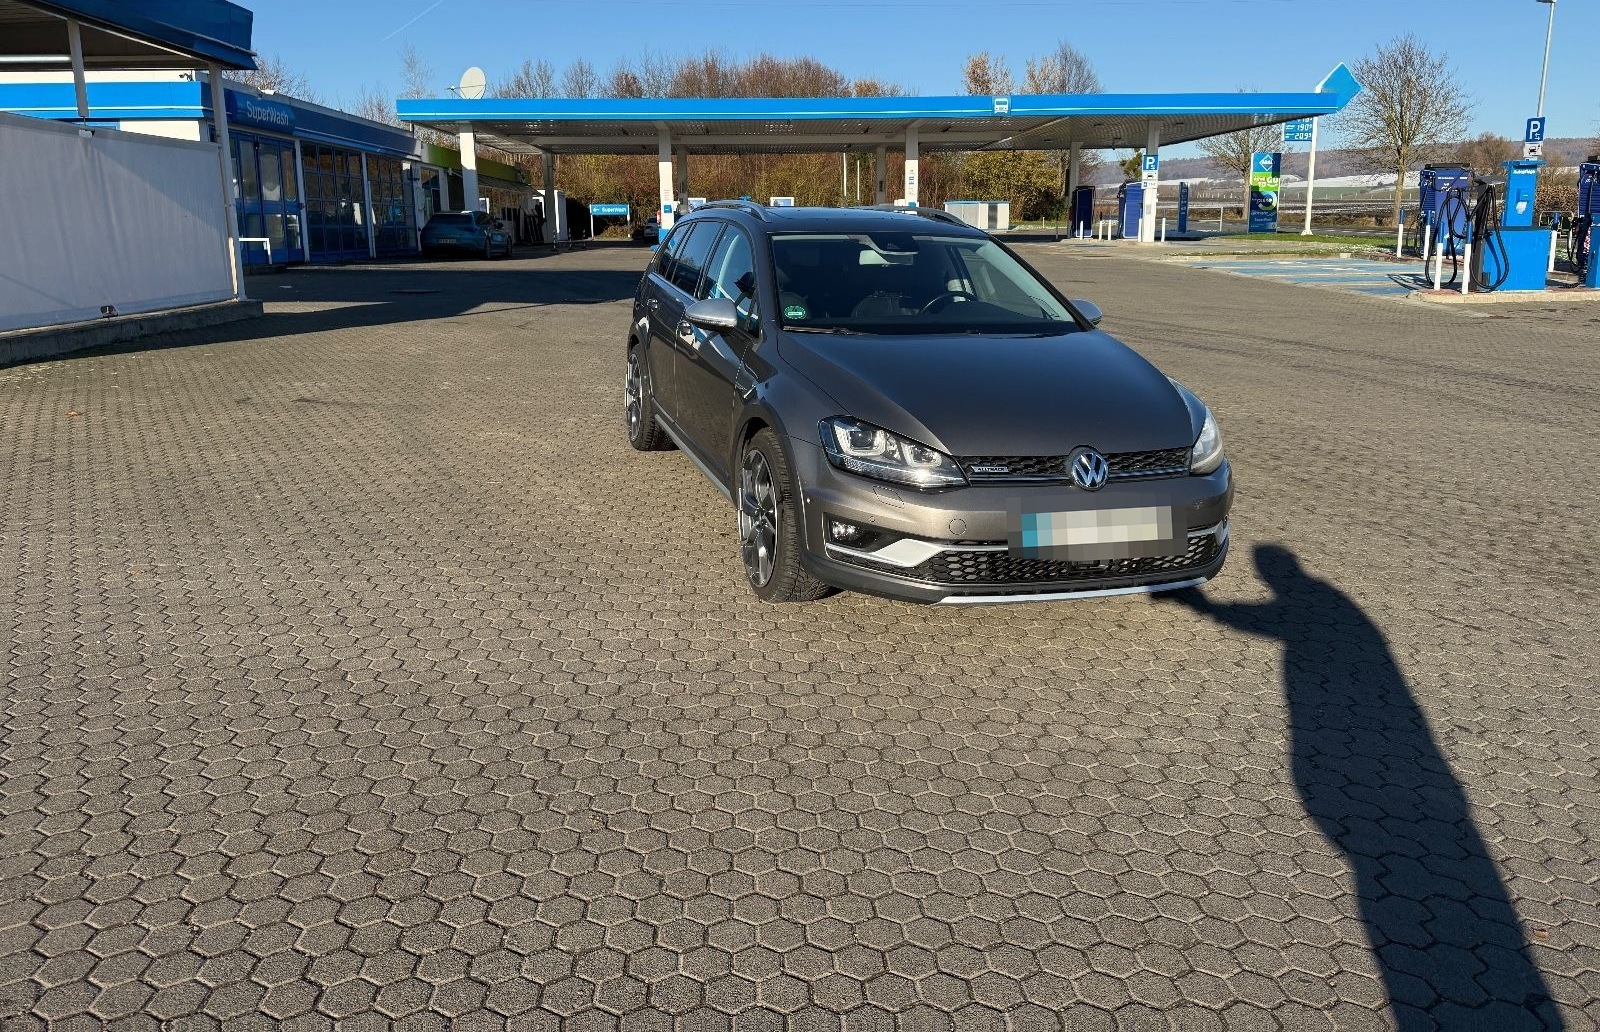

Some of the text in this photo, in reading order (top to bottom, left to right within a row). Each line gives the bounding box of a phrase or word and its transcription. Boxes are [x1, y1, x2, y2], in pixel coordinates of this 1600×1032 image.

[247, 101, 289, 126] SuperWash
[1529, 120, 1541, 140] P
[1146, 156, 1155, 169] P
